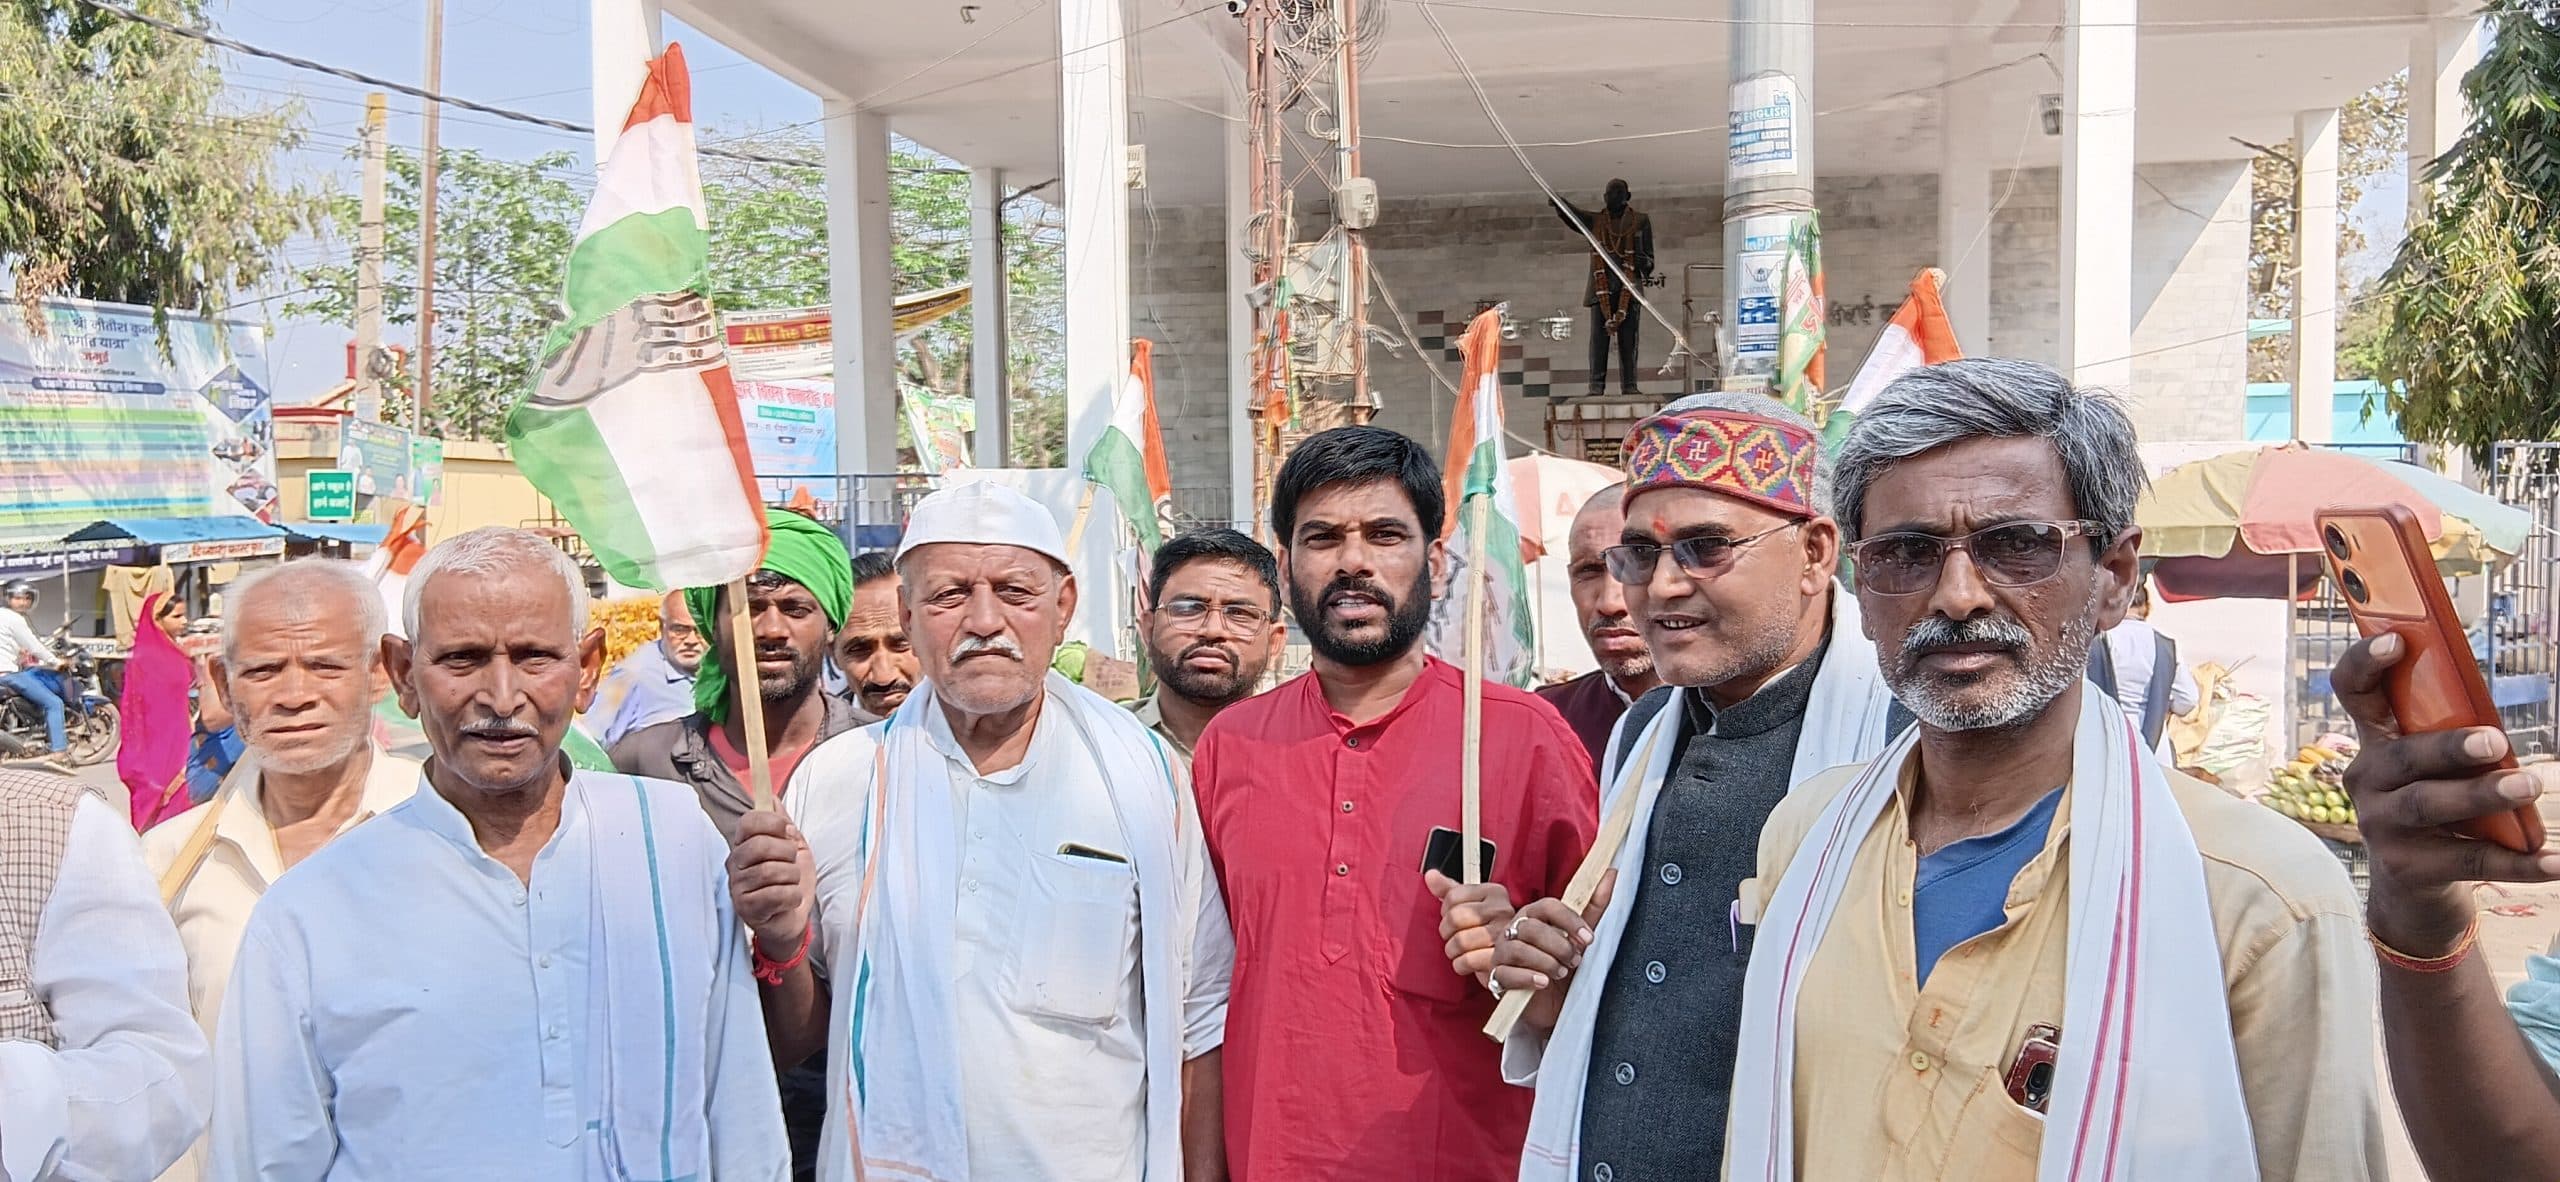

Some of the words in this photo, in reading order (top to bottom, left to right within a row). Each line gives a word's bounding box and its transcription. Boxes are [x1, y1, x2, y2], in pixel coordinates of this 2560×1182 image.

[1743, 106, 1790, 123] ENGLISH
[744, 327, 766, 342] All
[768, 324, 800, 340] The
